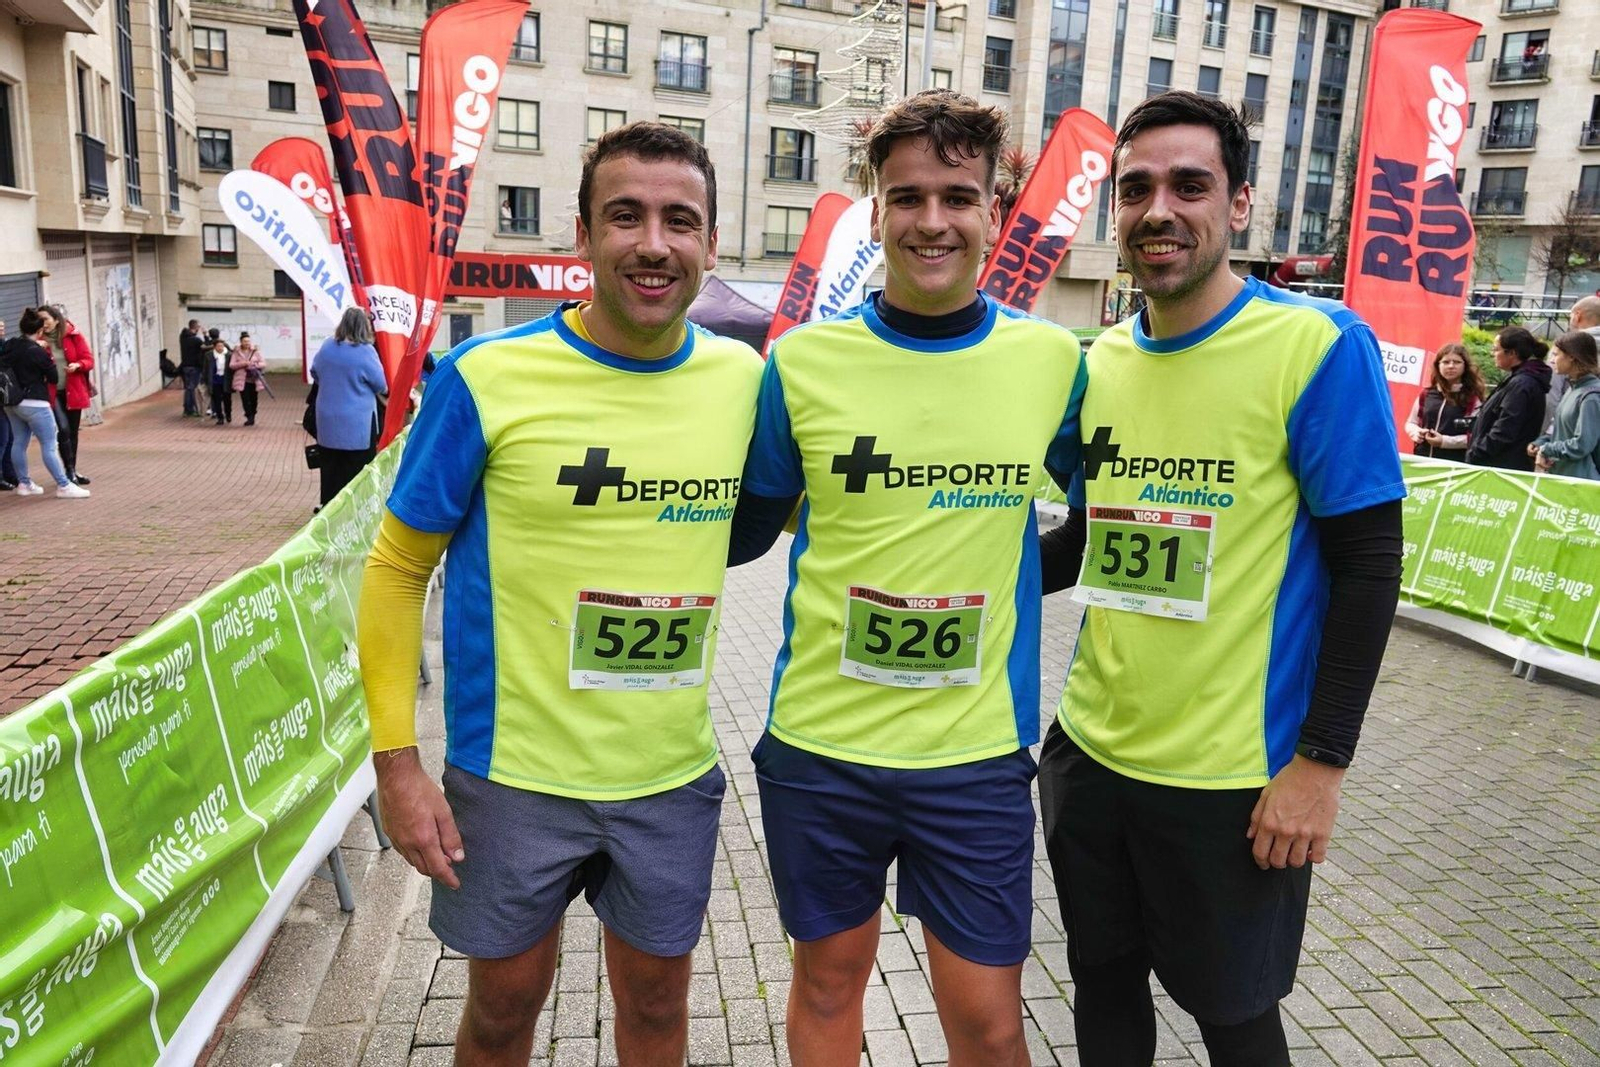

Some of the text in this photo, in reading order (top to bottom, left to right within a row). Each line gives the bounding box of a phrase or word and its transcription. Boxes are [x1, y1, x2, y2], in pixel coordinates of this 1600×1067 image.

[1361, 153, 1419, 283] RUN
[982, 212, 1042, 300] RUN
[781, 261, 816, 322] RUN
[617, 478, 739, 502] DEPORTE
[883, 463, 1030, 489] DEPORTE
[1111, 457, 1235, 483] DEPORTE
[657, 502, 733, 523] Atlántico
[928, 488, 1024, 509] Atlántico
[1138, 483, 1234, 508] Atlántico
[1100, 531, 1180, 583] 531
[1466, 556, 1495, 577] auga
[1556, 577, 1594, 602] auga
[211, 602, 243, 654] máis
[249, 583, 281, 622] auga
[593, 615, 691, 660] 525
[864, 612, 961, 659] 526
[643, 663, 674, 671] GONZALEZ
[875, 659, 894, 667] Daniel
[90, 672, 139, 743] máis
[154, 641, 192, 692] auga
[243, 730, 276, 787] máis
[281, 697, 313, 739] auga
[135, 833, 193, 903] máis
[189, 783, 229, 840] auga
[45, 912, 123, 995] auga
